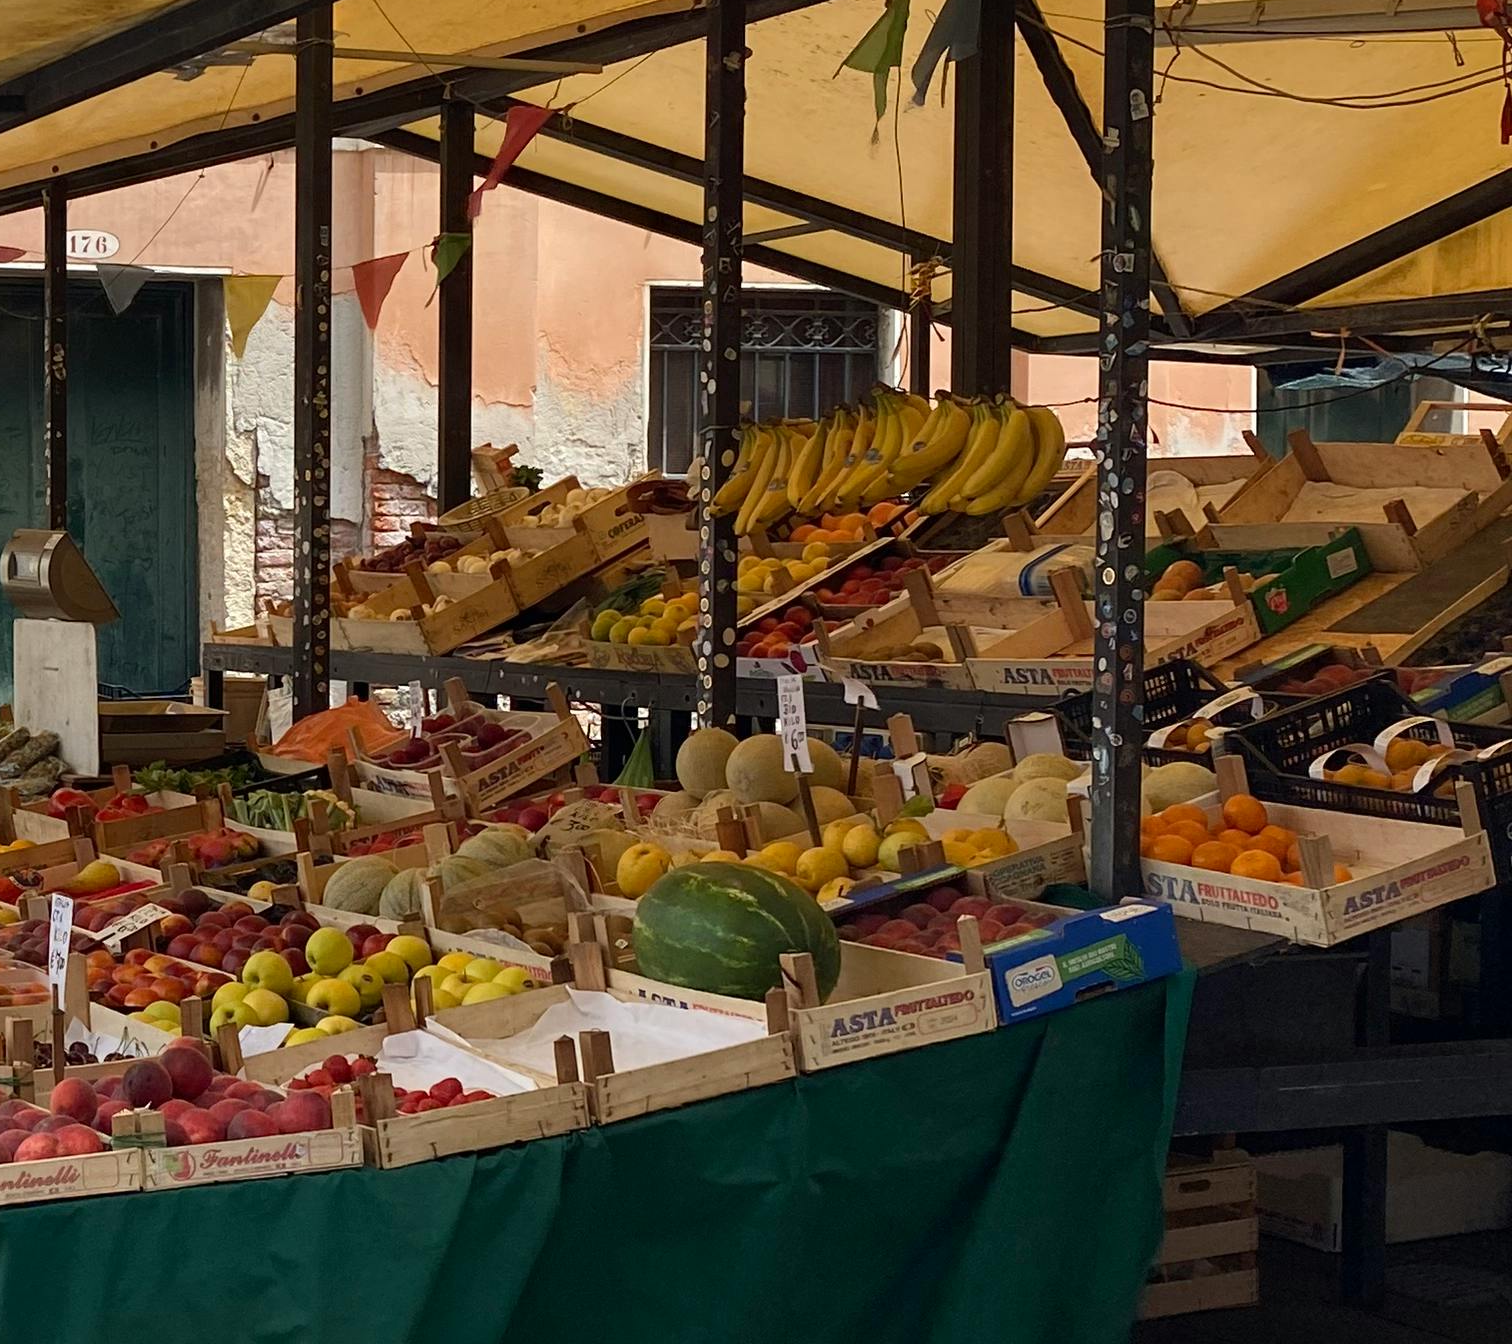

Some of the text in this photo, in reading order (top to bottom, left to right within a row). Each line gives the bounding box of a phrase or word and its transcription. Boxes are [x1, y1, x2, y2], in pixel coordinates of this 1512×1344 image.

[1004, 667, 1056, 685] ASTA
[1147, 872, 1280, 910] STA FRUTTALTEDO
[1343, 881, 1402, 915] ASTA
[830, 1007, 897, 1038] ASTA
[199, 1142, 305, 1170] Fantinell
